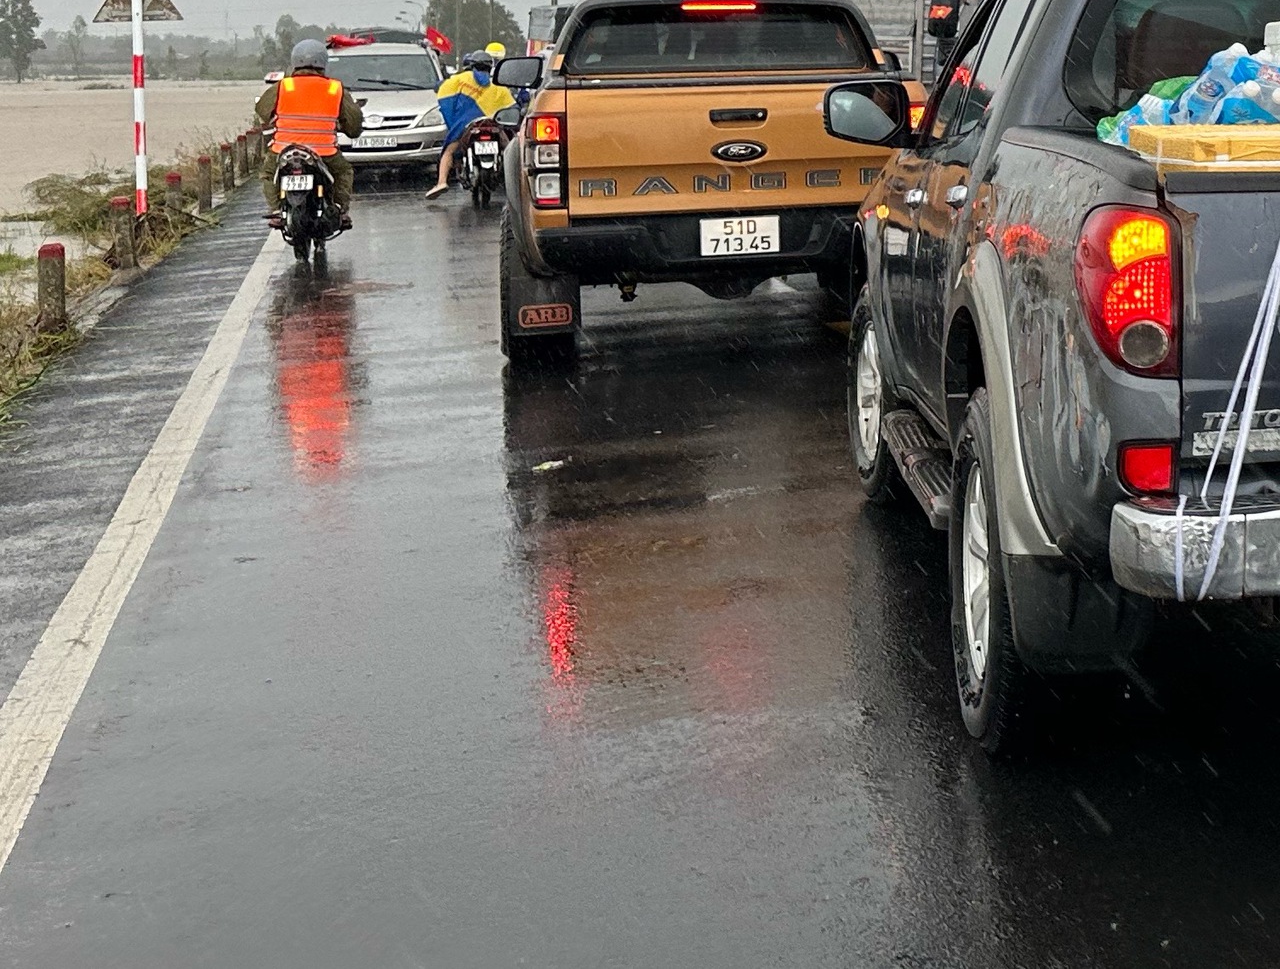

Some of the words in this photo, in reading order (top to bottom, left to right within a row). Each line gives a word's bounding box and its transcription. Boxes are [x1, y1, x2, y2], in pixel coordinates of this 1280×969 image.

[723, 219, 757, 236] 51D
[709, 235, 771, 253] 713.45
[524, 307, 568, 325] ARB
